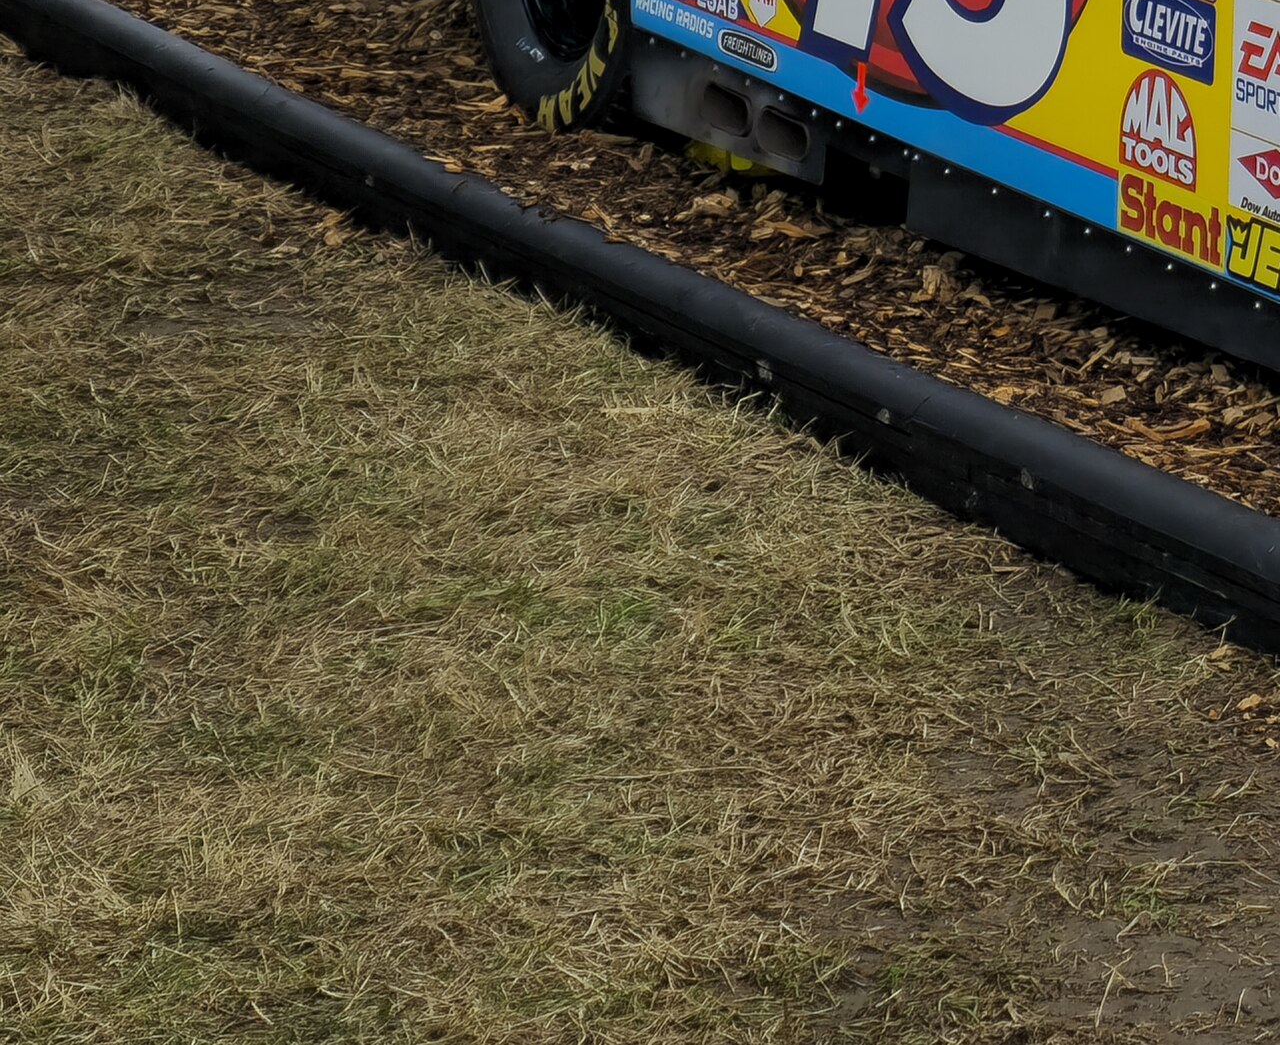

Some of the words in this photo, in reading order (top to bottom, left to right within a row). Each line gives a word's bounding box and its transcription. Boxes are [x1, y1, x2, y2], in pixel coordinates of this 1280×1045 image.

[676, 10, 714, 39] RADIOS
[722, 33, 773, 65] FREIGHTLINER
[1134, 38, 1170, 55] ENGINE
[1171, 48, 1203, 67] PARTS
[1123, 76, 1195, 158] MAC
[1123, 139, 1194, 185] TOOLS
[1120, 174, 1222, 268] Stant
[1240, 197, 1261, 215] Dow
